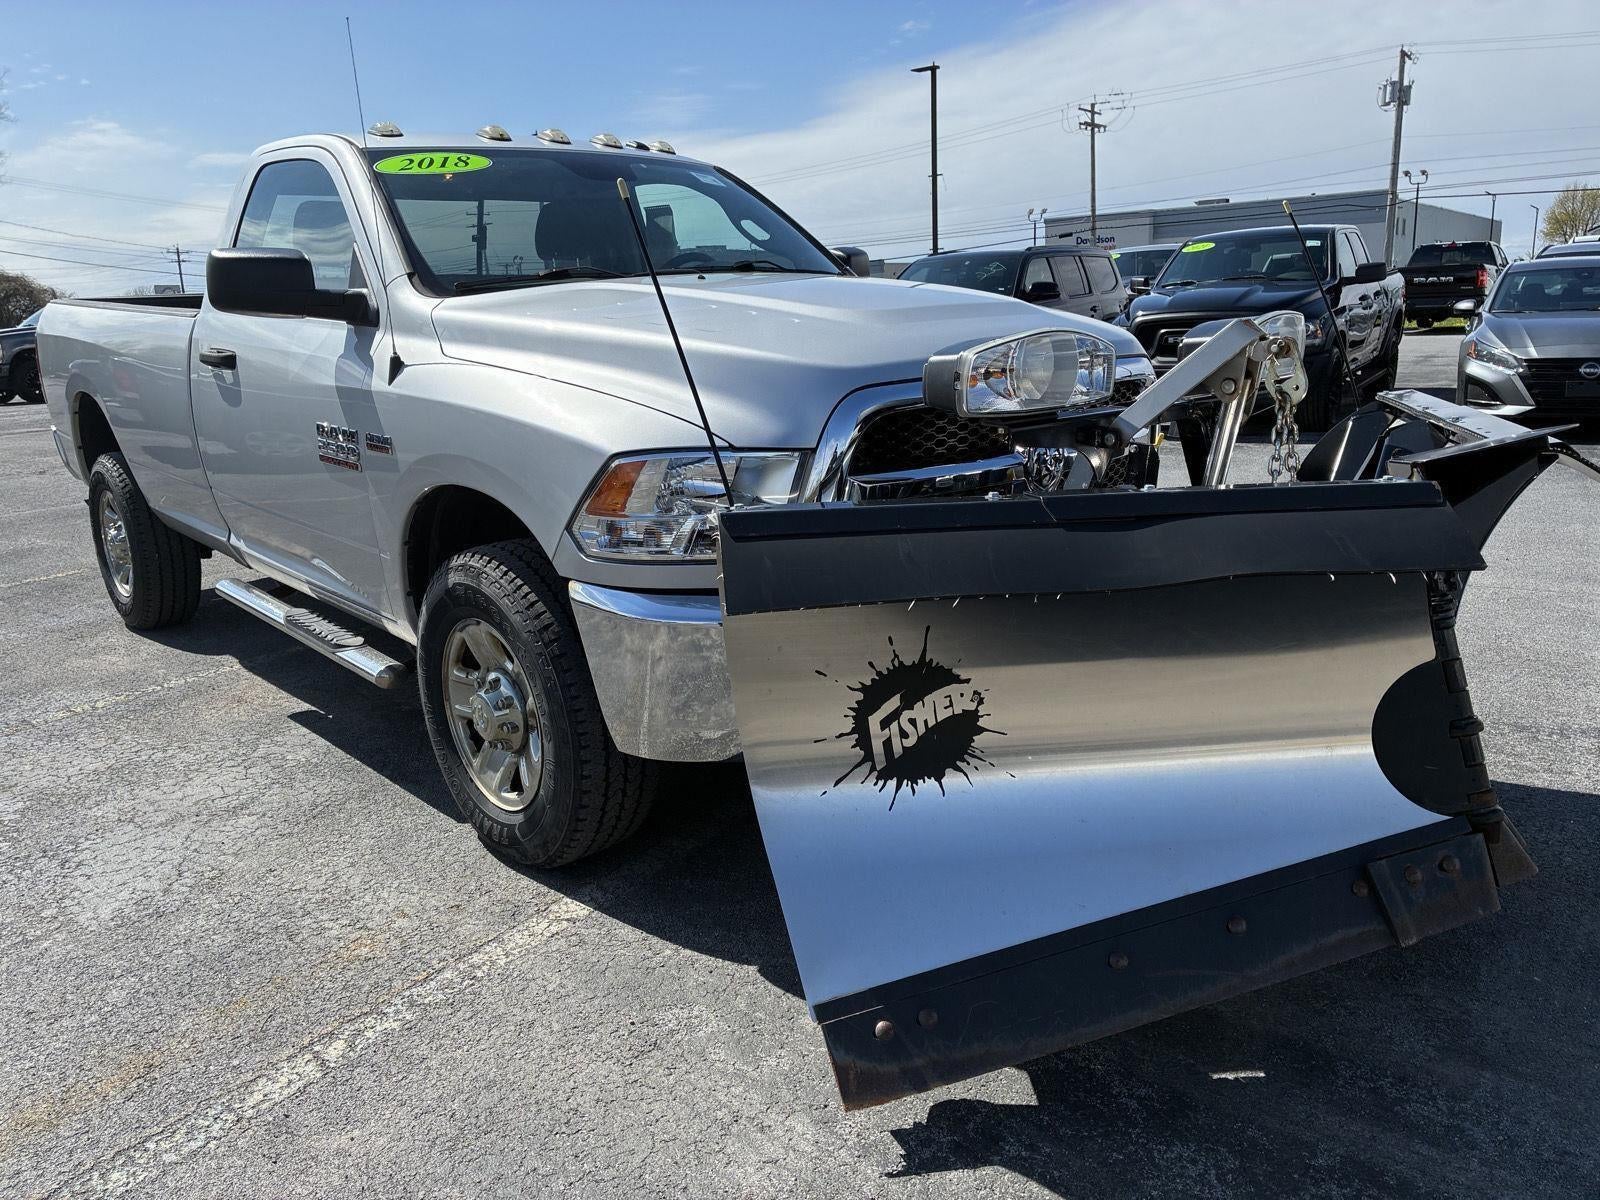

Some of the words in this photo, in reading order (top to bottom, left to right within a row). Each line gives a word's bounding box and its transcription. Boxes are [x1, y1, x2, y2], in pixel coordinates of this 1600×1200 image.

[398, 156, 471, 171] 2018
[1076, 235, 1115, 244] Davdson
[1413, 276, 1454, 284] RAM
[316, 421, 359, 444] RAM
[317, 438, 360, 462] 2500
[868, 683, 975, 771] FISHER
